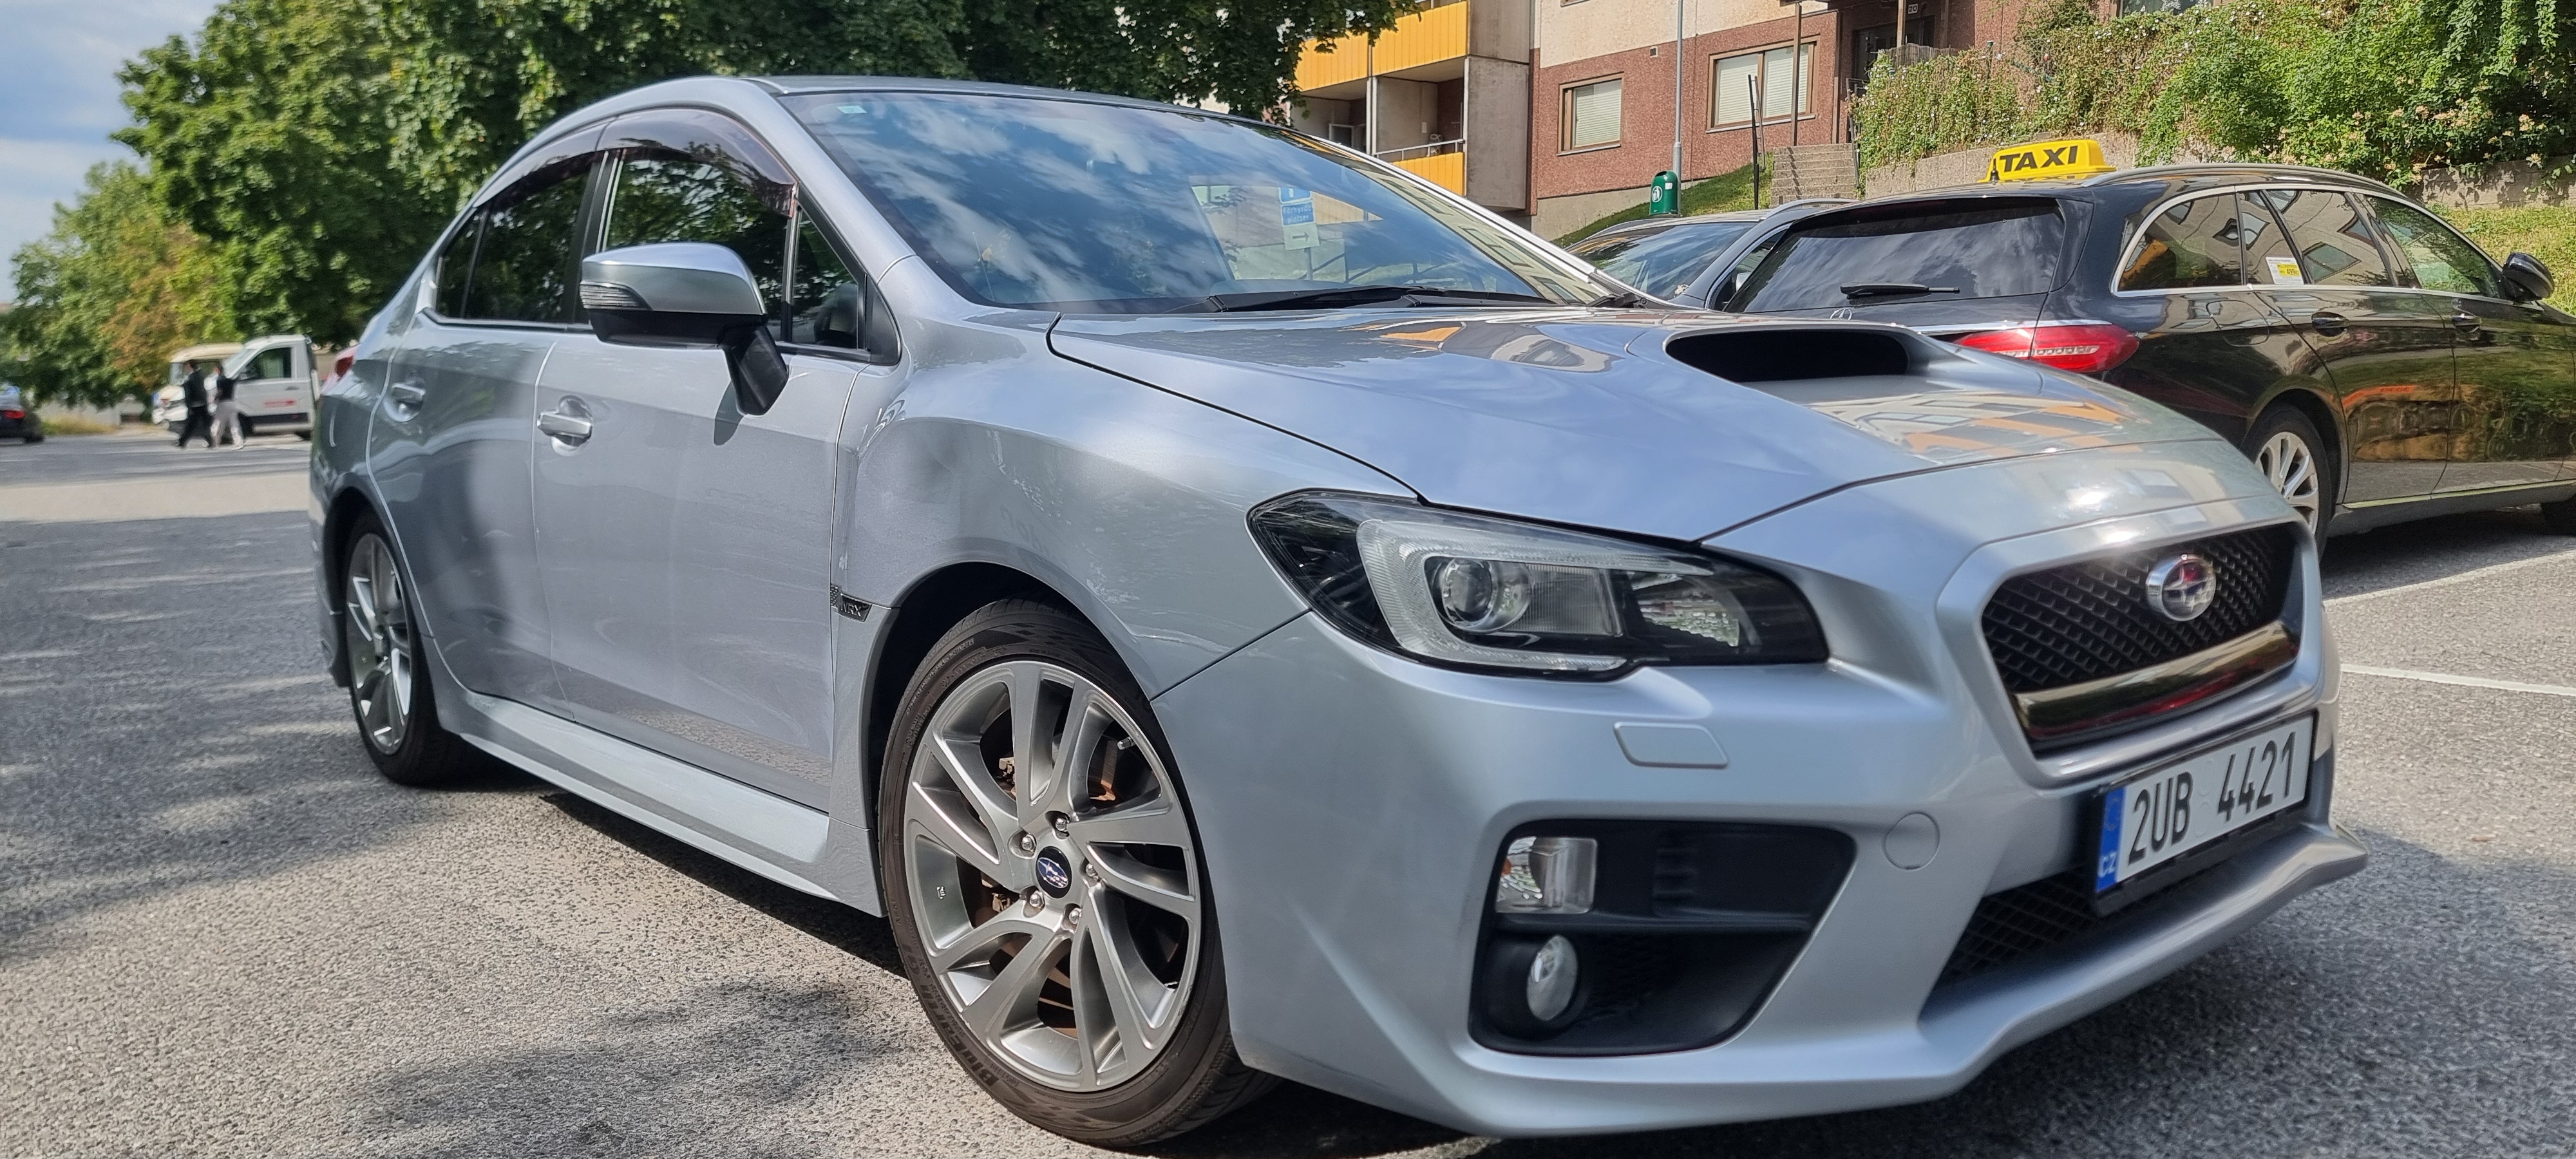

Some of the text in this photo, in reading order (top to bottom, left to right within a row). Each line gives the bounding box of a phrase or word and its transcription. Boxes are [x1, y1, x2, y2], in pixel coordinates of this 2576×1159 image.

[1999, 146, 2079, 173] TAXI
[2128, 731, 2297, 866] 2UB 4421
[2098, 852, 2117, 878] CZ
